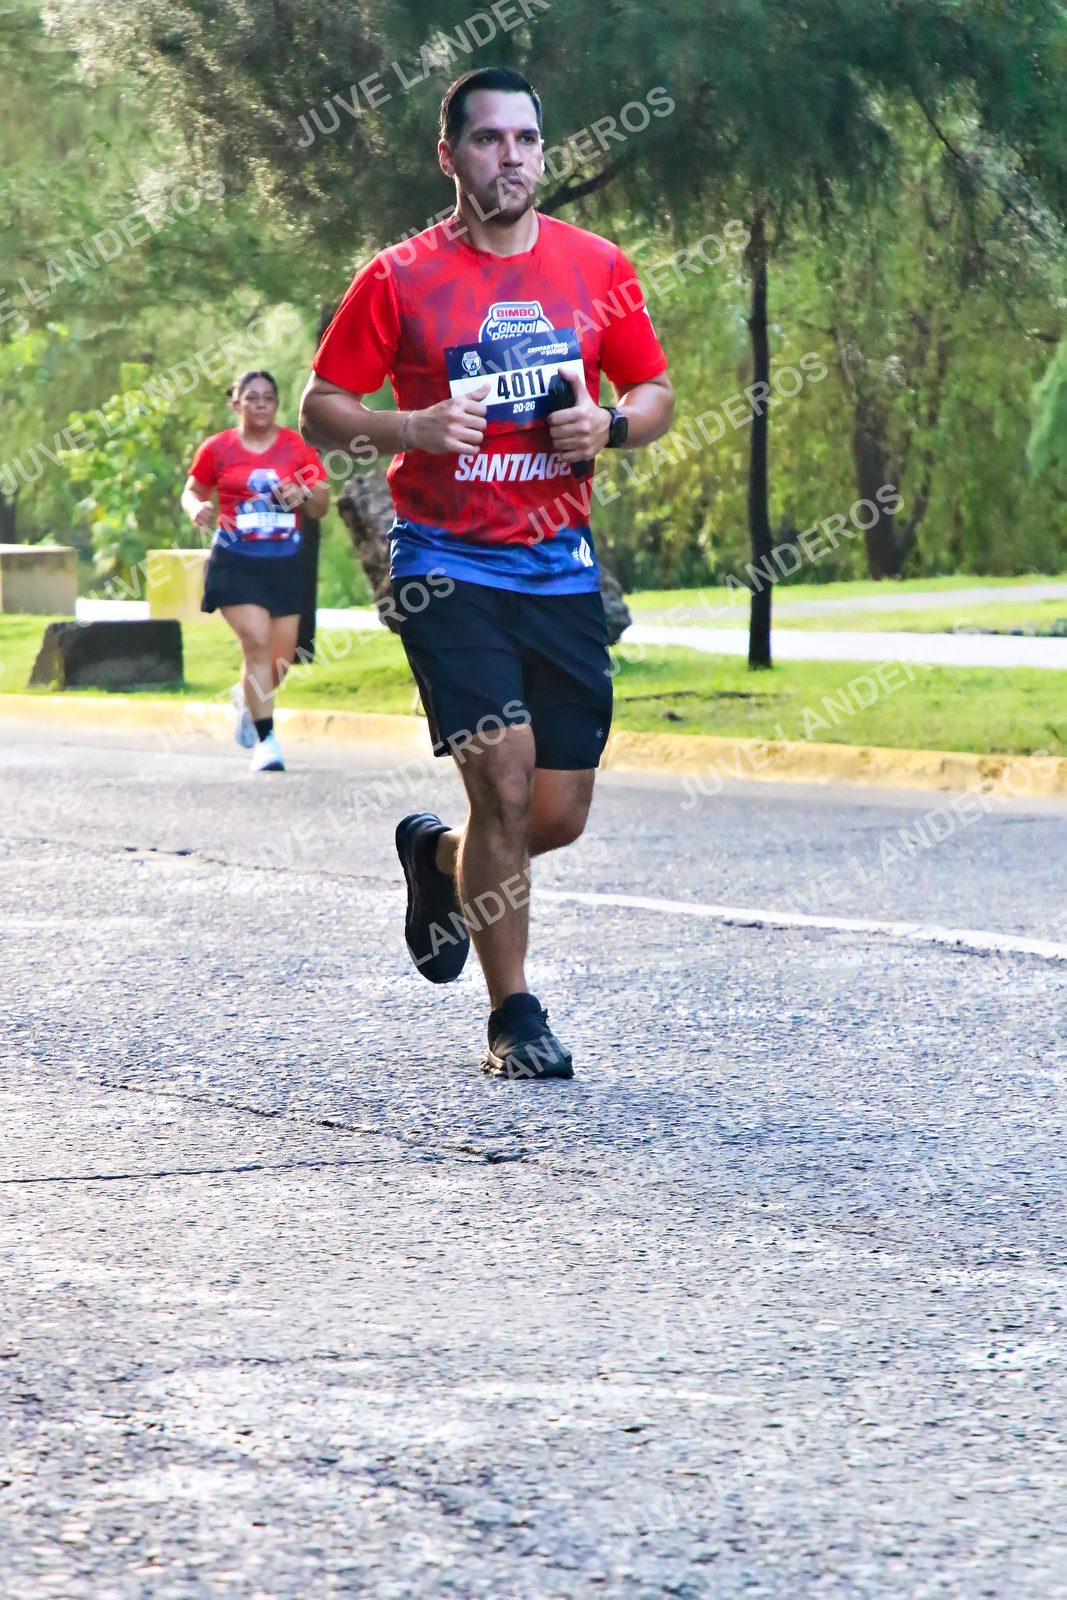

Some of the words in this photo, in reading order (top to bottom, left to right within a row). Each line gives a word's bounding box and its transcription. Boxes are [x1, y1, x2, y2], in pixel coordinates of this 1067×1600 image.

[496, 308, 536, 318] BIMBO
[498, 321, 537, 334] Global
[497, 368, 546, 400] 4011
